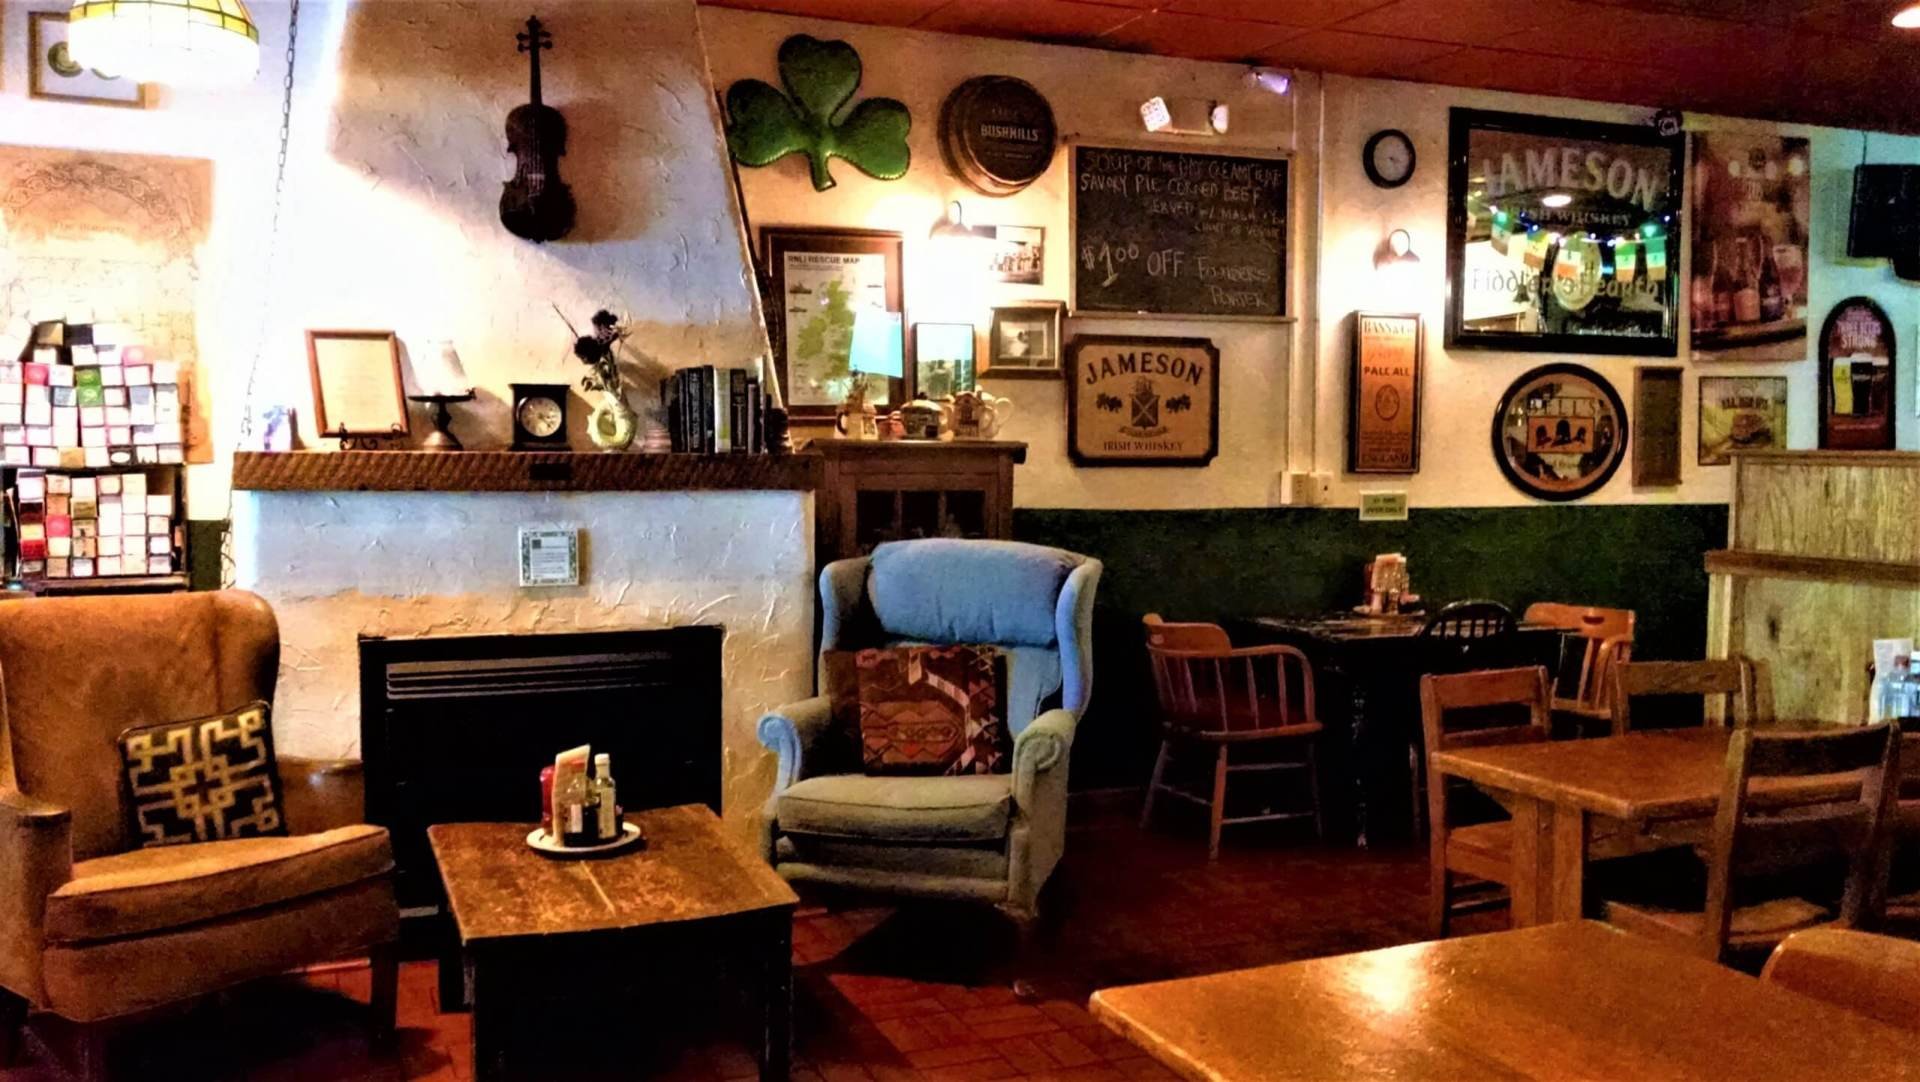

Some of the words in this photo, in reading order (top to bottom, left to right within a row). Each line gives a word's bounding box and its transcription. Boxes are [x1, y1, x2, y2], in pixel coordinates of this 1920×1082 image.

[980, 124, 1039, 142] BUSHMILLS
[1482, 147, 1659, 213] JAMESON
[808, 255, 841, 265] RESCUE
[843, 256, 860, 265] MAP
[1147, 250, 1185, 278] OFF
[1086, 352, 1203, 387] JAMESON
[1104, 440, 1130, 451] IRISH
[1134, 440, 1184, 452] WHISKEY
